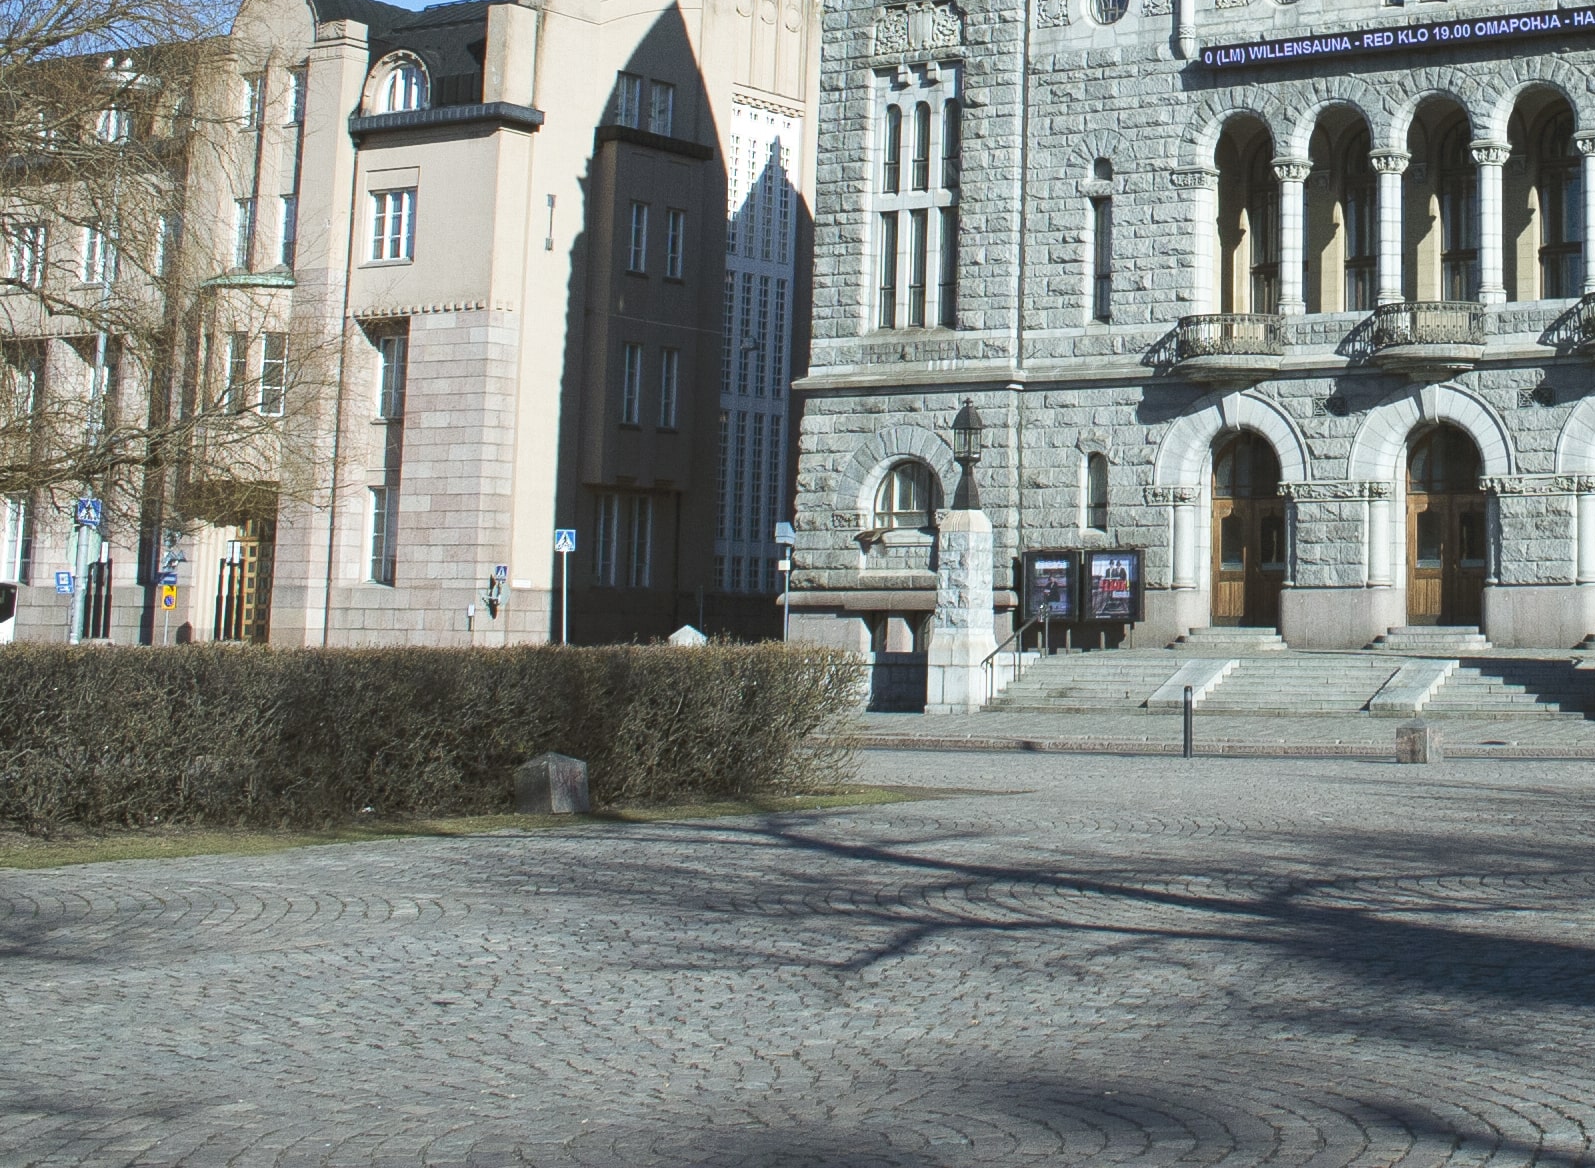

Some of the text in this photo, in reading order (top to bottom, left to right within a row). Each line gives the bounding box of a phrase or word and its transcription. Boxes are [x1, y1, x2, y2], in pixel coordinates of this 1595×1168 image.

[1204, 51, 1213, 64] 0
[1216, 48, 1246, 66] (LM)
[1248, 36, 1352, 60] WILLENSAUNA
[1363, 31, 1394, 48] RED
[1397, 28, 1429, 44] KLO
[1432, 23, 1471, 41] 19.00
[1474, 14, 1562, 36] OMAPOHJA
